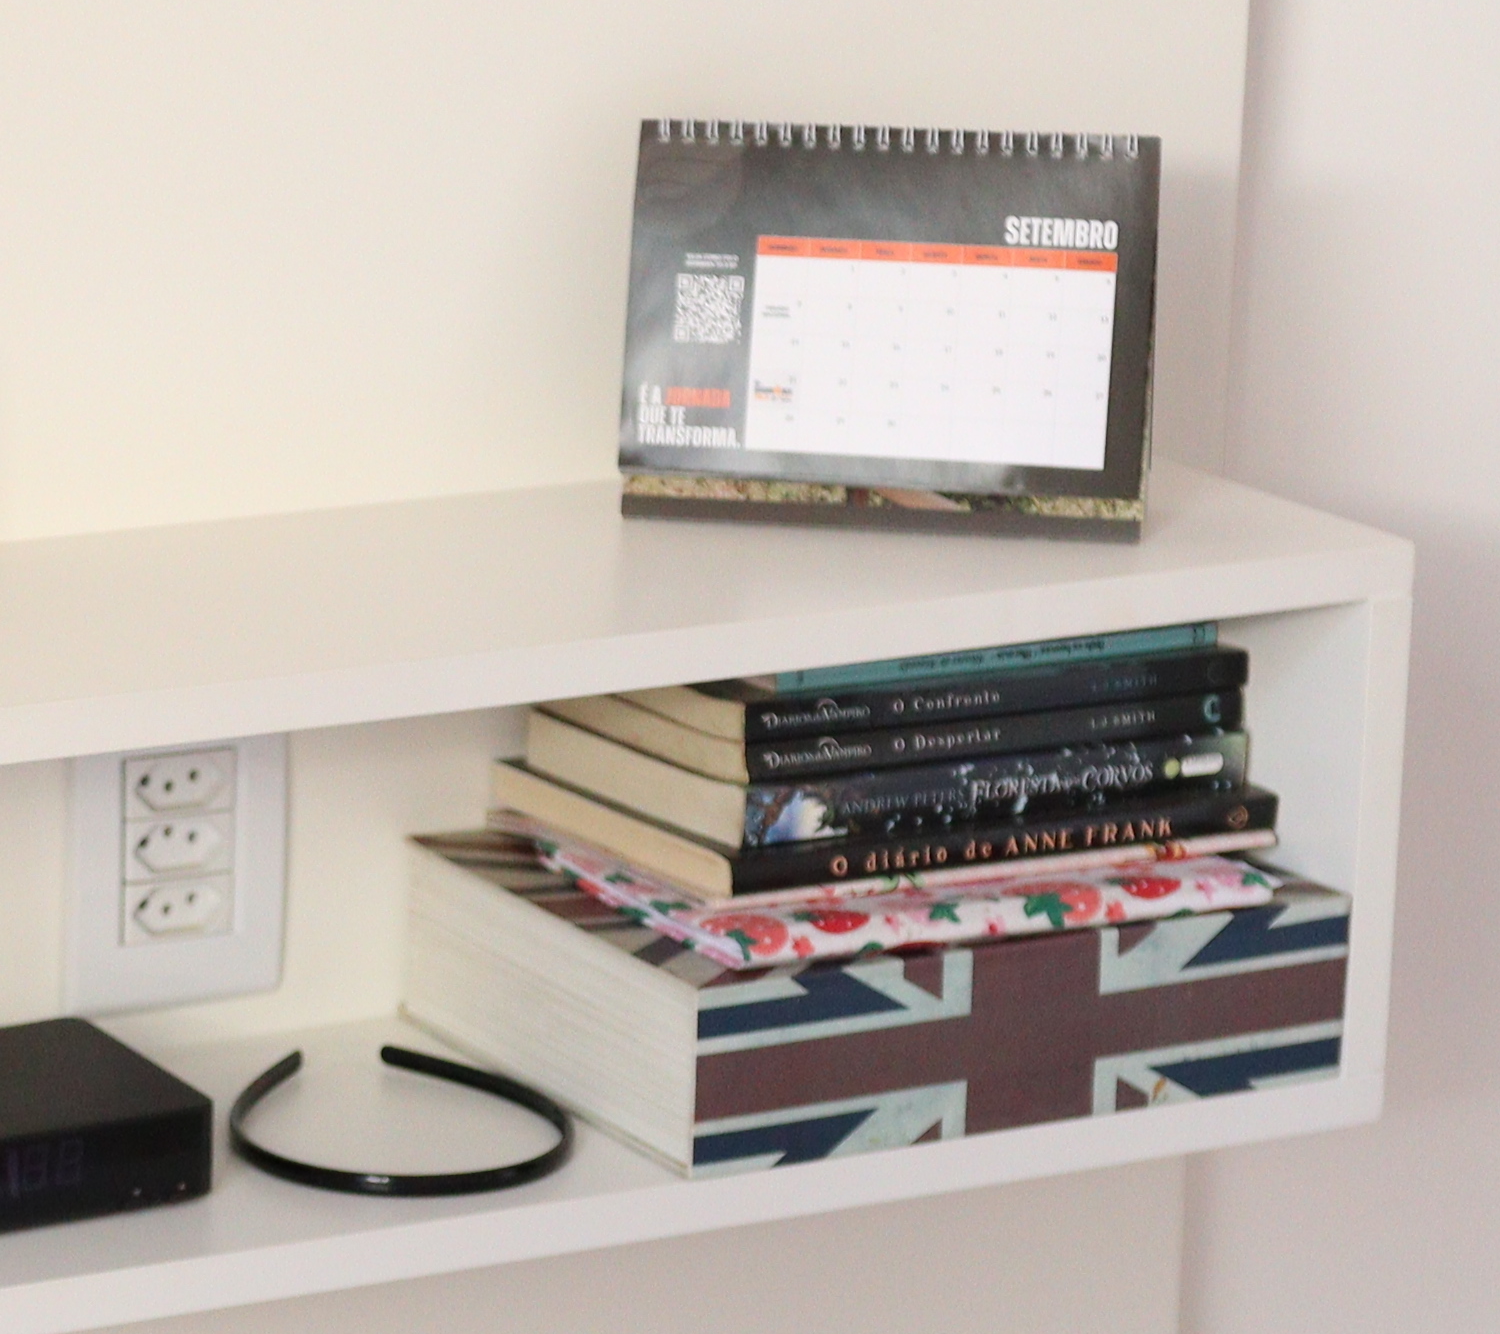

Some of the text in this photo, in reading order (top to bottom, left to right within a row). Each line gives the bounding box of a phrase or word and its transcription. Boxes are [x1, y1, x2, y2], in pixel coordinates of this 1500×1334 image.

[1004, 215, 1119, 250] SETEMBRO
[830, 817, 1173, 876] O diário de ANNE FRANK
